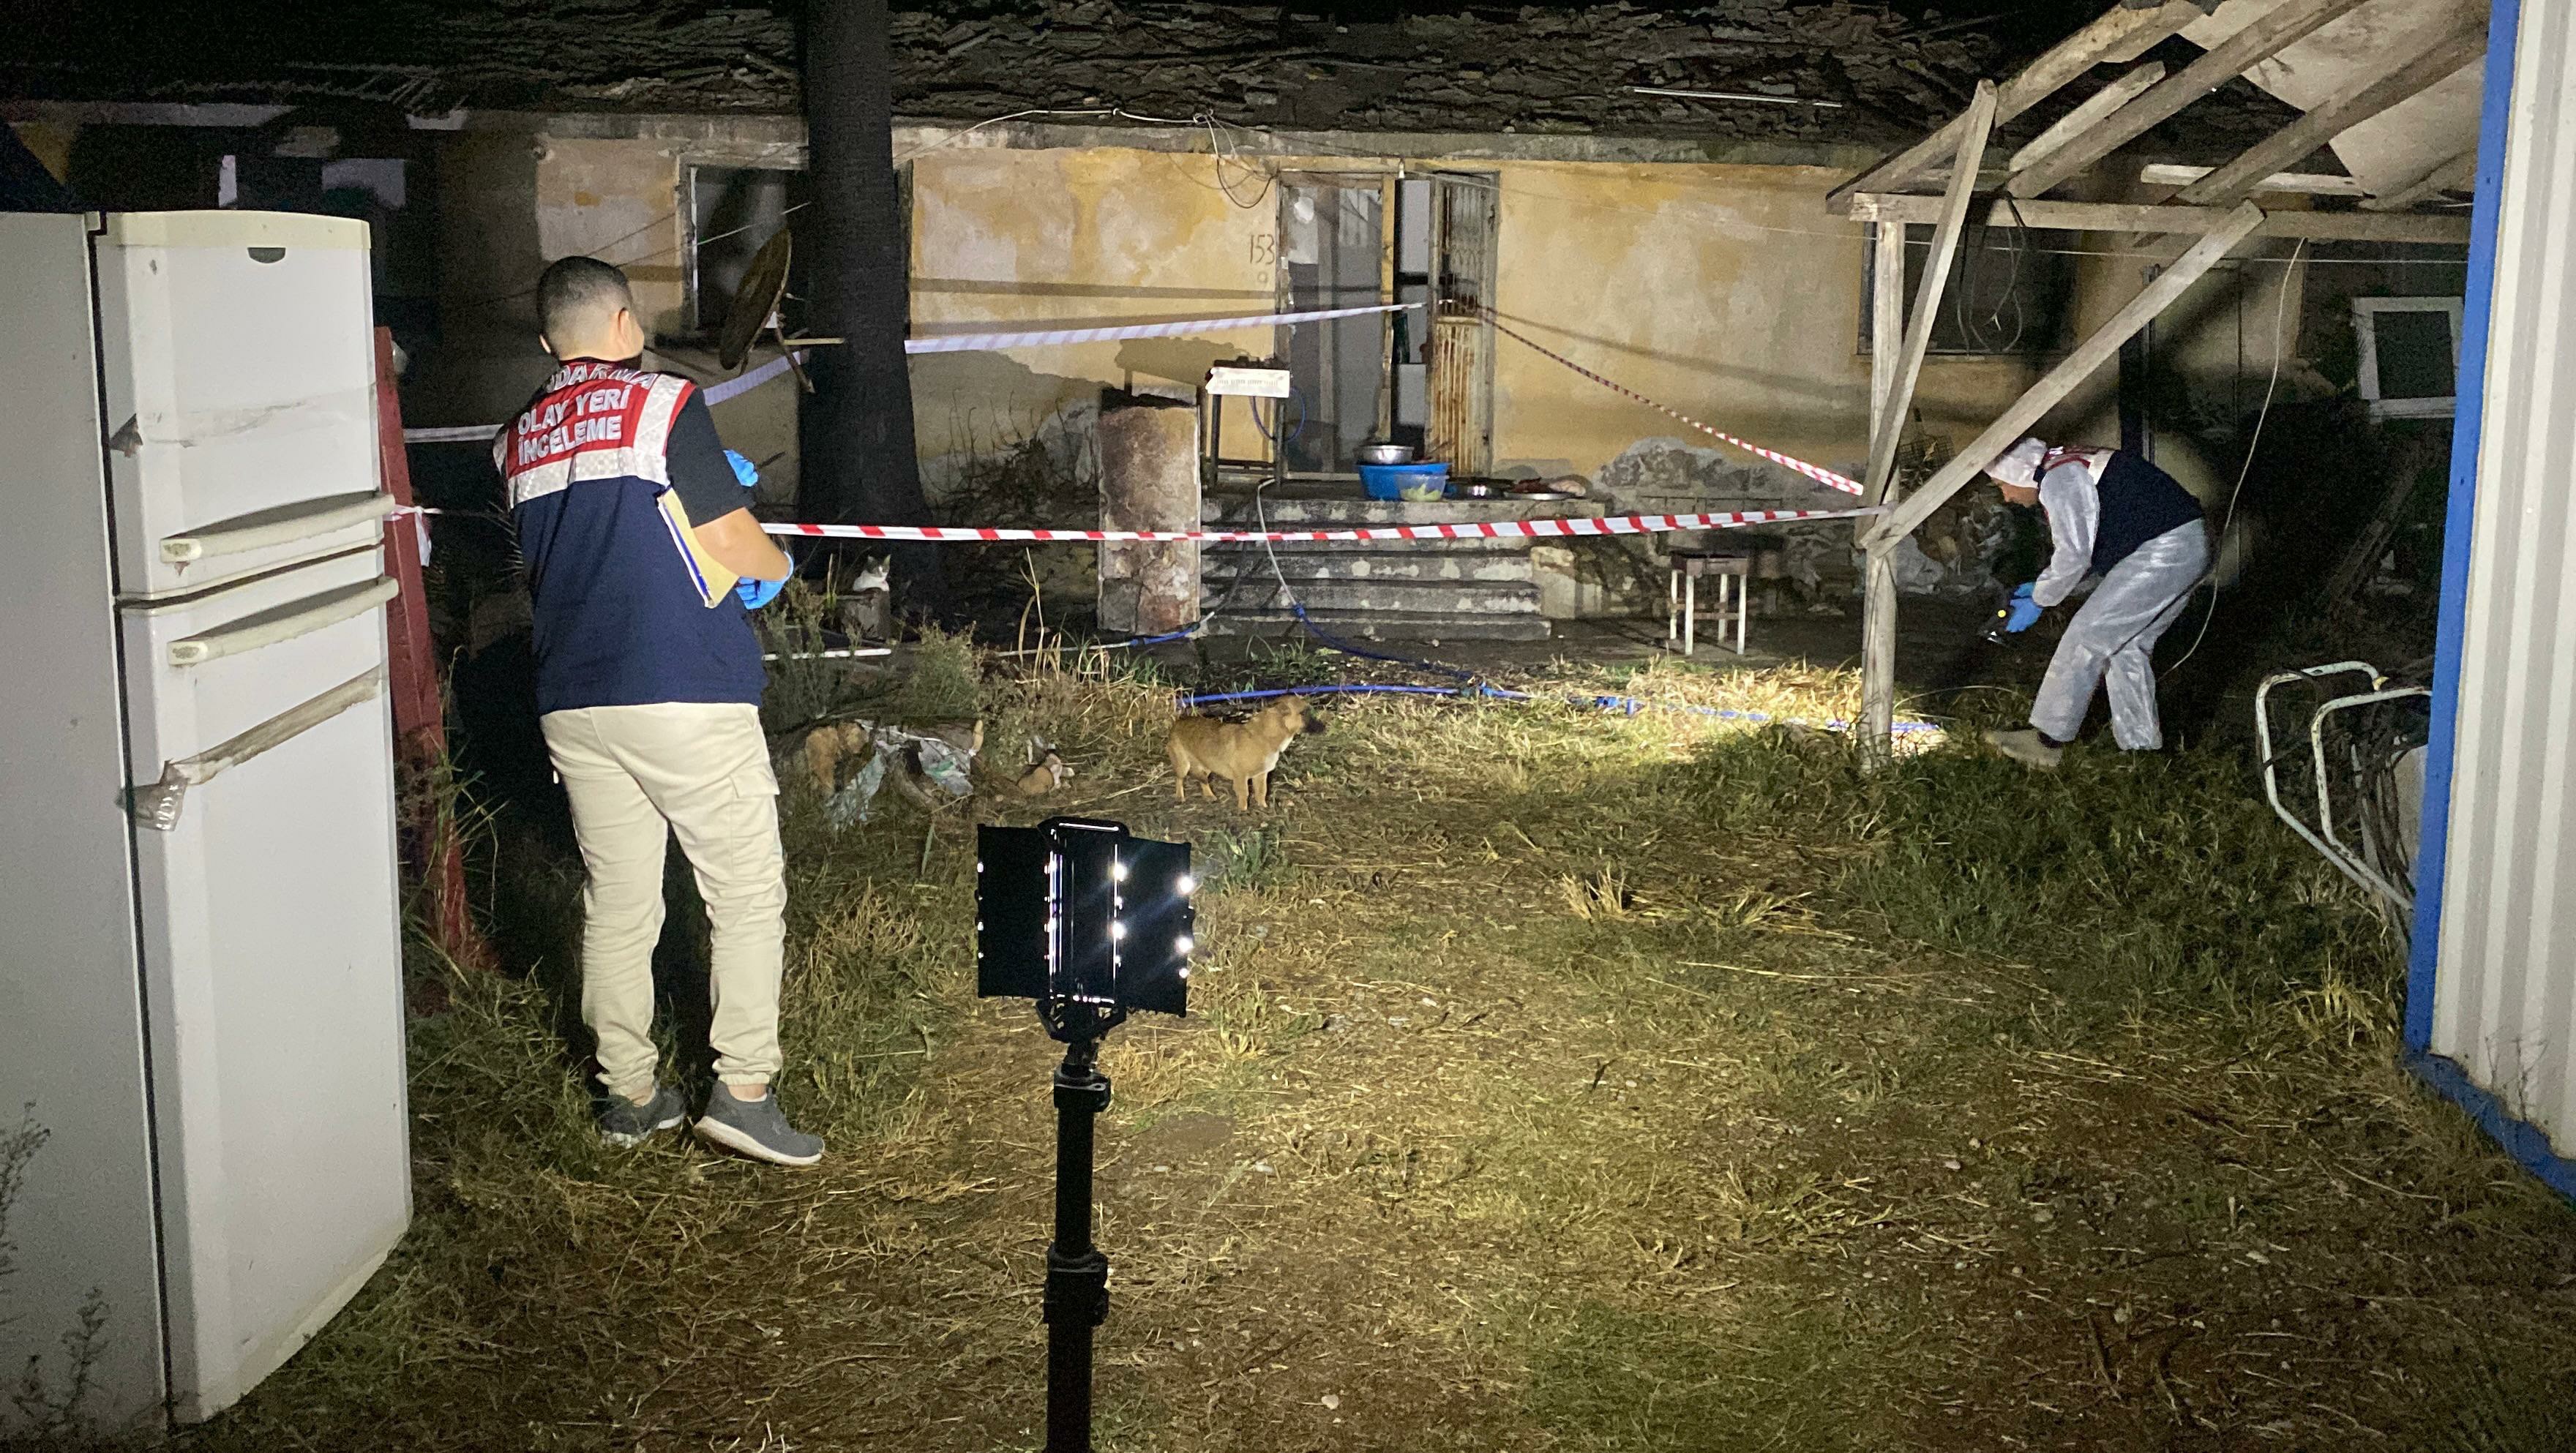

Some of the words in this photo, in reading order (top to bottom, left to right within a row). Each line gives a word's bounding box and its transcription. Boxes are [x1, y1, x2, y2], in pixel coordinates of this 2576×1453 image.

[1249, 233, 1275, 264] 153
[517, 399, 570, 435] OLAY
[576, 384, 633, 416] YERİ
[517, 415, 622, 466] İNCELEME
